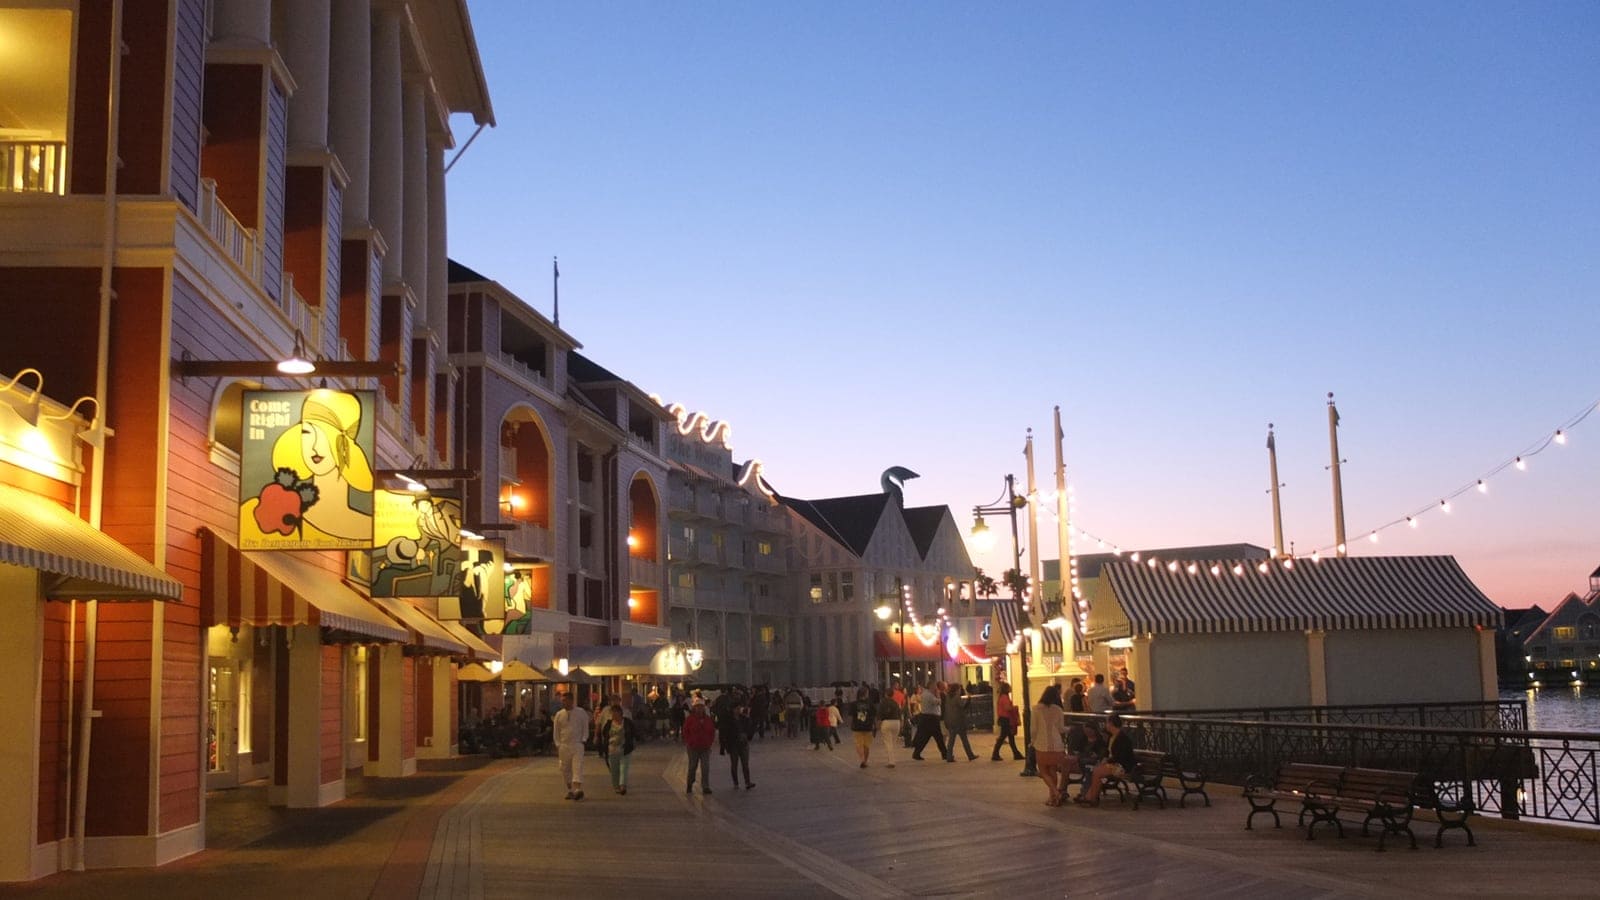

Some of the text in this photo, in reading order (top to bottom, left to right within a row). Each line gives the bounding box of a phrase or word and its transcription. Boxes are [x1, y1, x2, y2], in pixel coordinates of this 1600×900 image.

[250, 400, 290, 412] Come
[250, 413, 290, 428] Right
[250, 428, 265, 440] In
